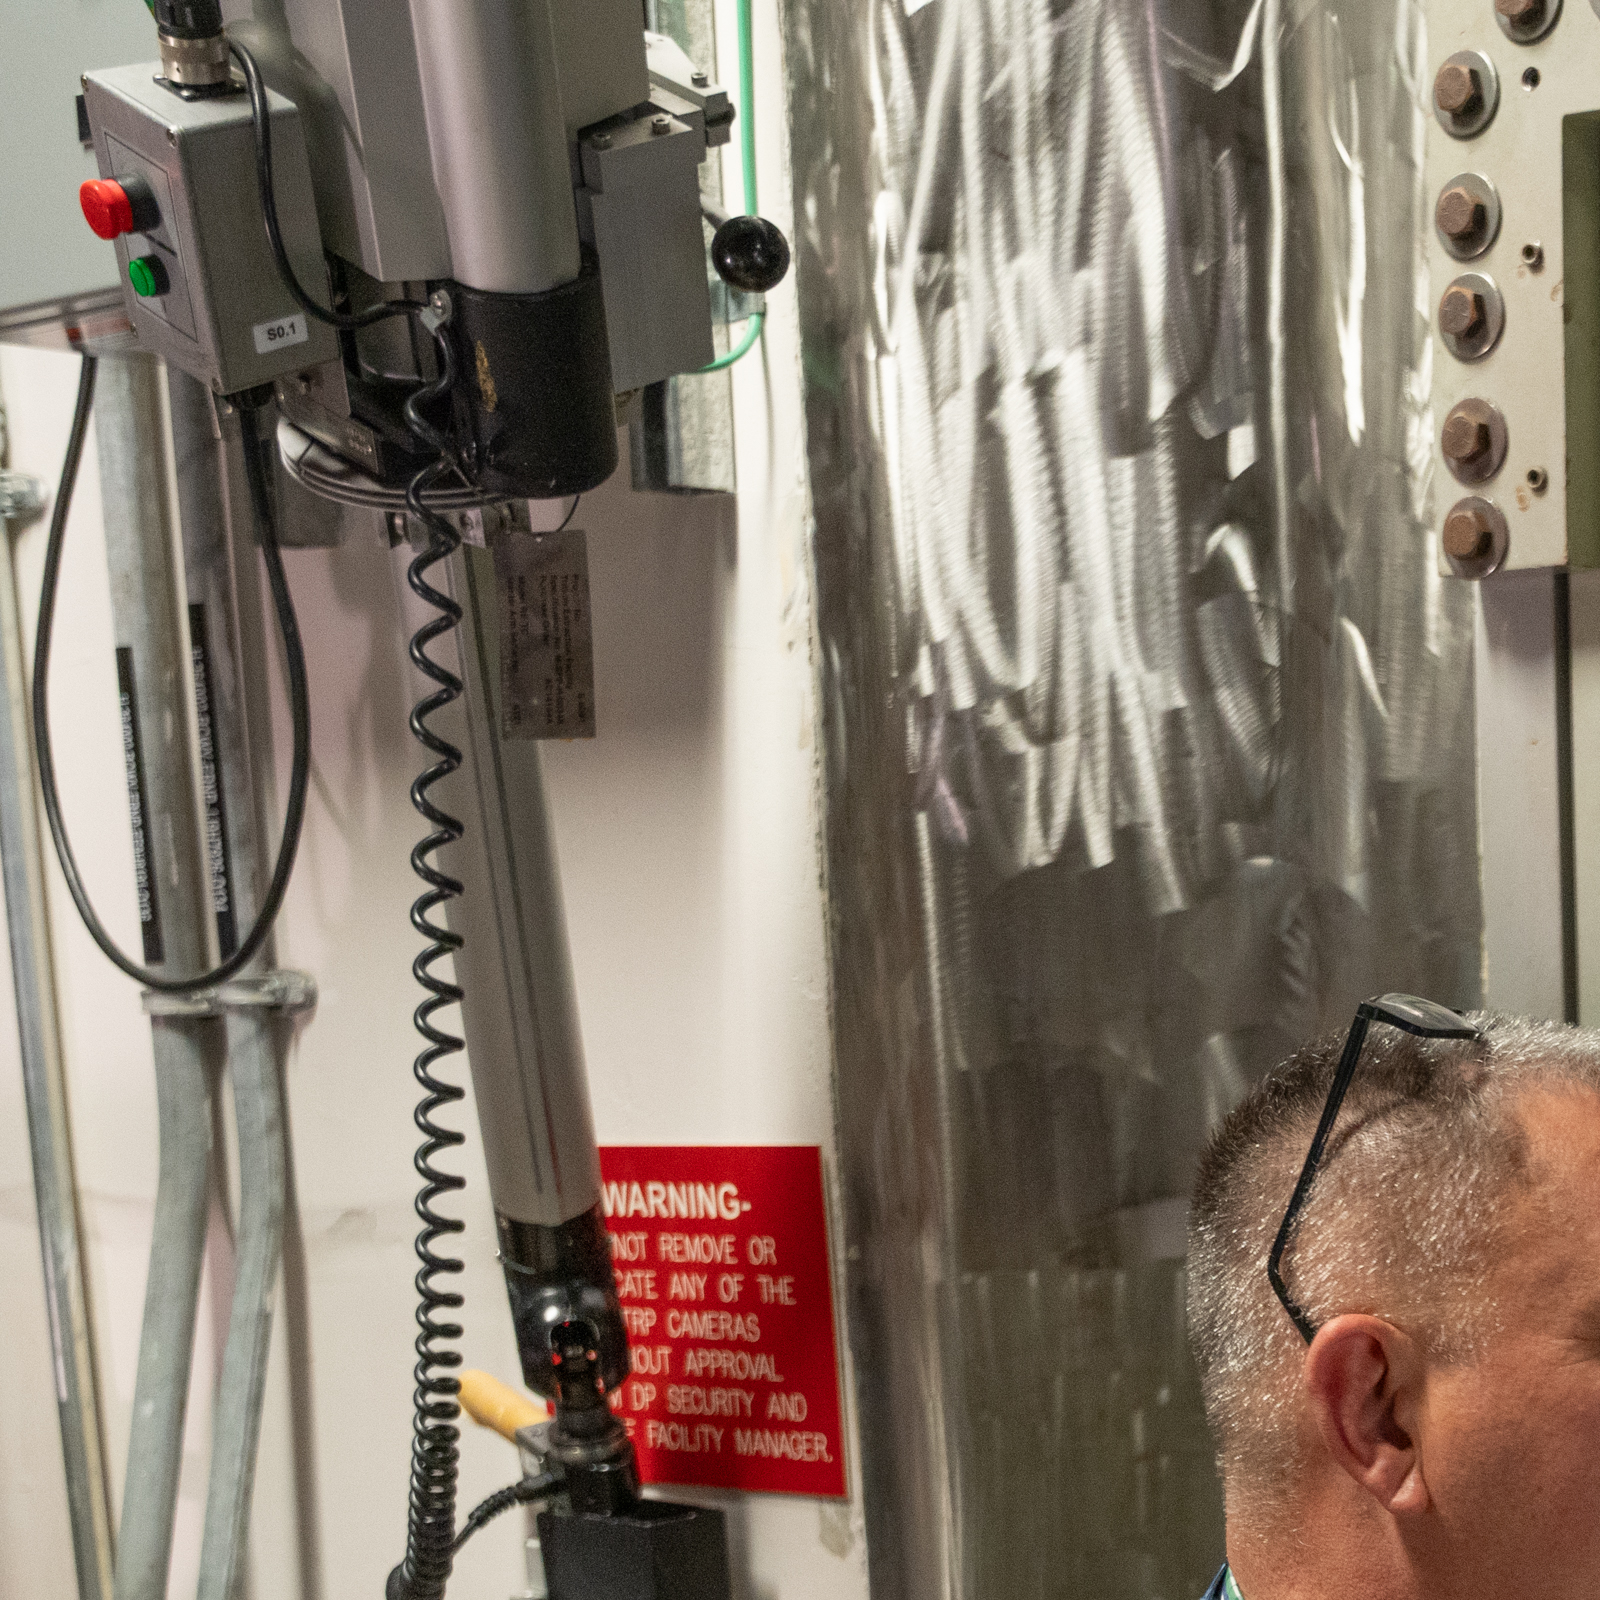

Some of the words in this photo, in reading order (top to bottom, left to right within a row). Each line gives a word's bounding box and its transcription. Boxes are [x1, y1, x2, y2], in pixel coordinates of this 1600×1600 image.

[267, 321, 296, 341] S0.1
[659, 1231, 738, 1265] REMOVE
[748, 1234, 777, 1266] OR
[669, 1271, 707, 1301] ANY
[718, 1272, 745, 1304] OF
[756, 1273, 796, 1306] THE
[666, 1307, 761, 1343] CAMERAS
[684, 1347, 784, 1383] APPROVAL
[631, 1381, 657, 1412] DP
[666, 1383, 755, 1418] SECURITY
[766, 1391, 808, 1423] AND
[646, 1419, 725, 1453] FACILITY
[732, 1426, 834, 1463] MANAGER.
